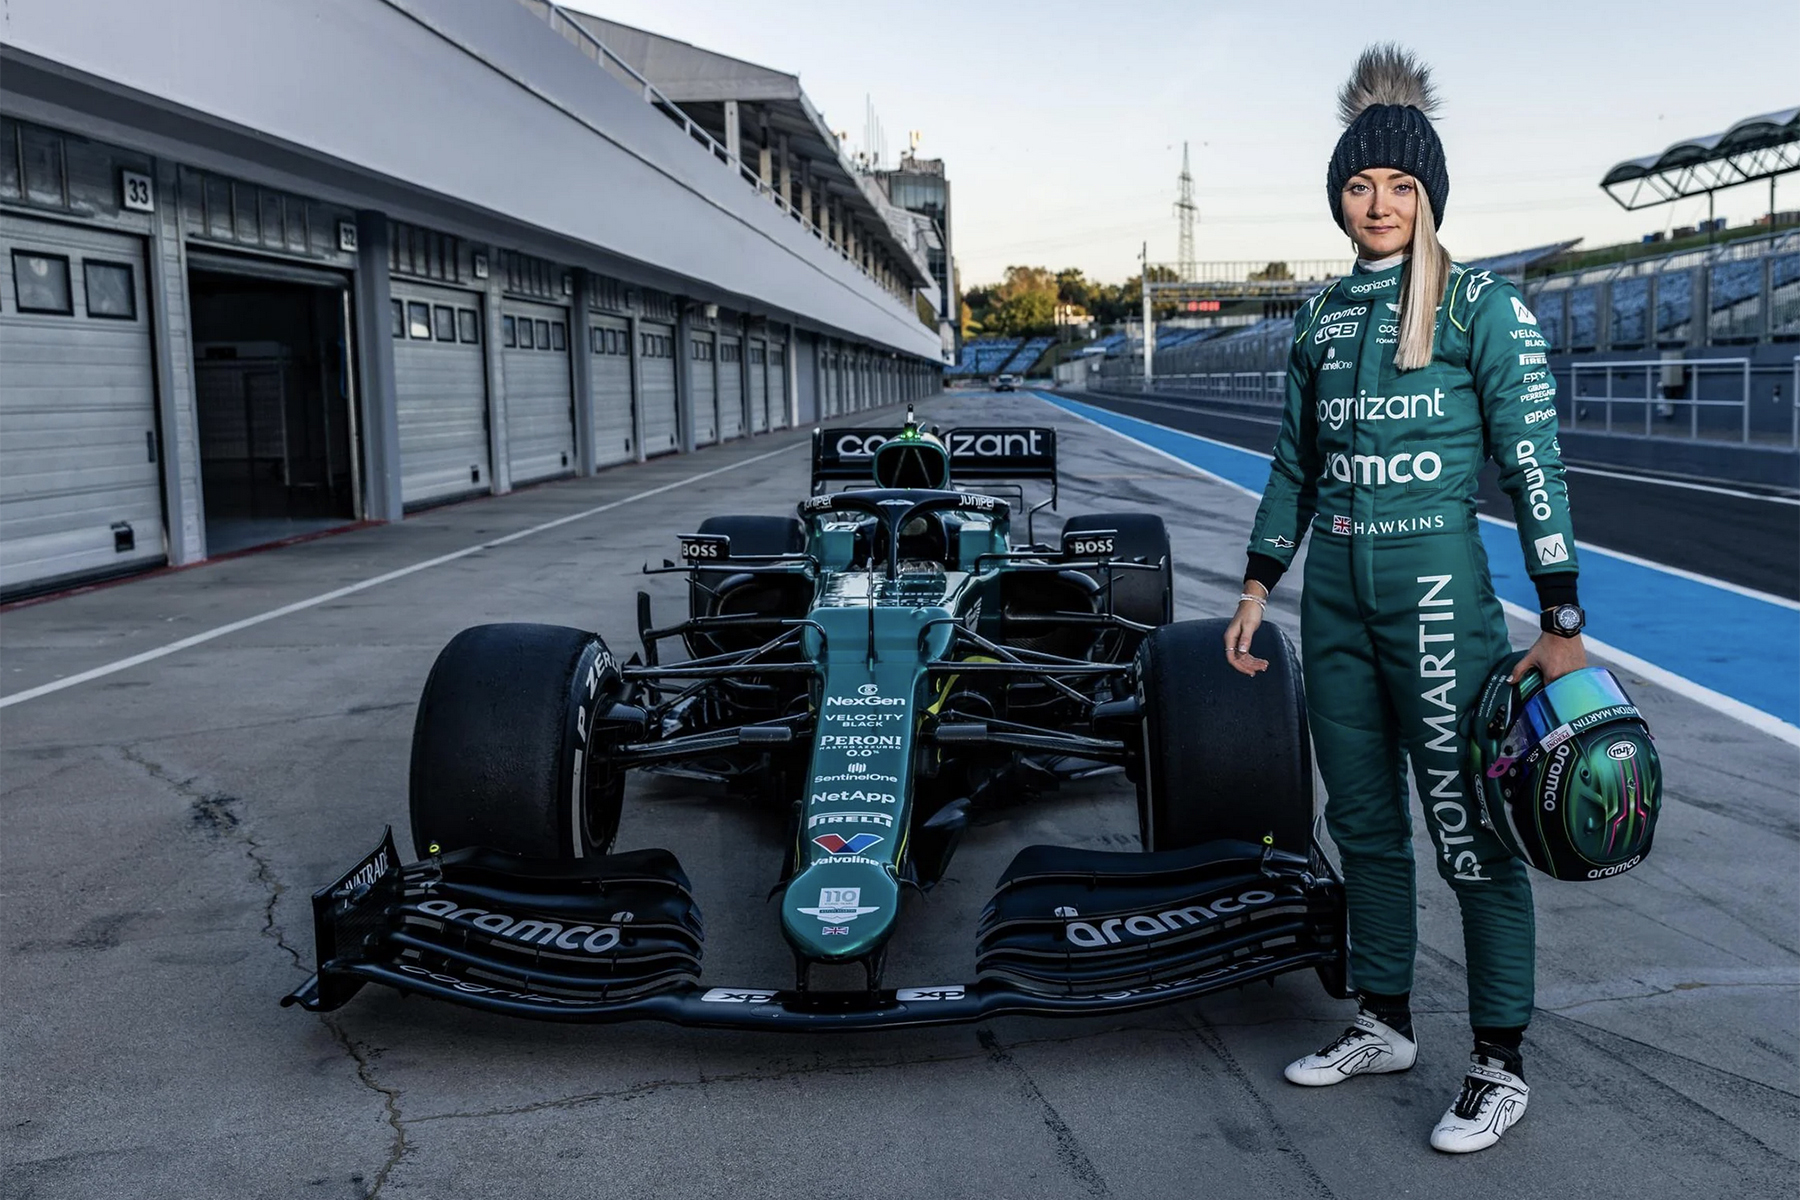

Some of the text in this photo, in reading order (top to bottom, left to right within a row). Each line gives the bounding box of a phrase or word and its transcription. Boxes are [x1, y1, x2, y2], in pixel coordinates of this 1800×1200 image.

[129, 179, 149, 204] 33
[1351, 277, 1397, 294] cognizant
[1320, 307, 1366, 324] aramco
[1316, 324, 1357, 342] JCB
[1519, 353, 1547, 365] PIREL
[1316, 387, 1445, 431] ognizant
[836, 430, 1041, 456] coizant
[1354, 515, 1444, 535] HAWKINS
[682, 543, 717, 557] BOSS
[1074, 539, 1114, 554] BOSS
[1417, 574, 1458, 752] MARTIN
[826, 696, 906, 706] NexGen
[1572, 709, 1612, 731] MARTIN
[820, 735, 902, 746] PERONI
[814, 773, 898, 784] SentinelOne
[1543, 744, 1570, 811] aramco
[810, 790, 896, 806] NetApp
[808, 811, 893, 829] PIRELLI
[1587, 854, 1641, 879] aramco
[824, 890, 857, 903] 110
[417, 900, 620, 954] aramco
[1066, 890, 1275, 948] aramco
